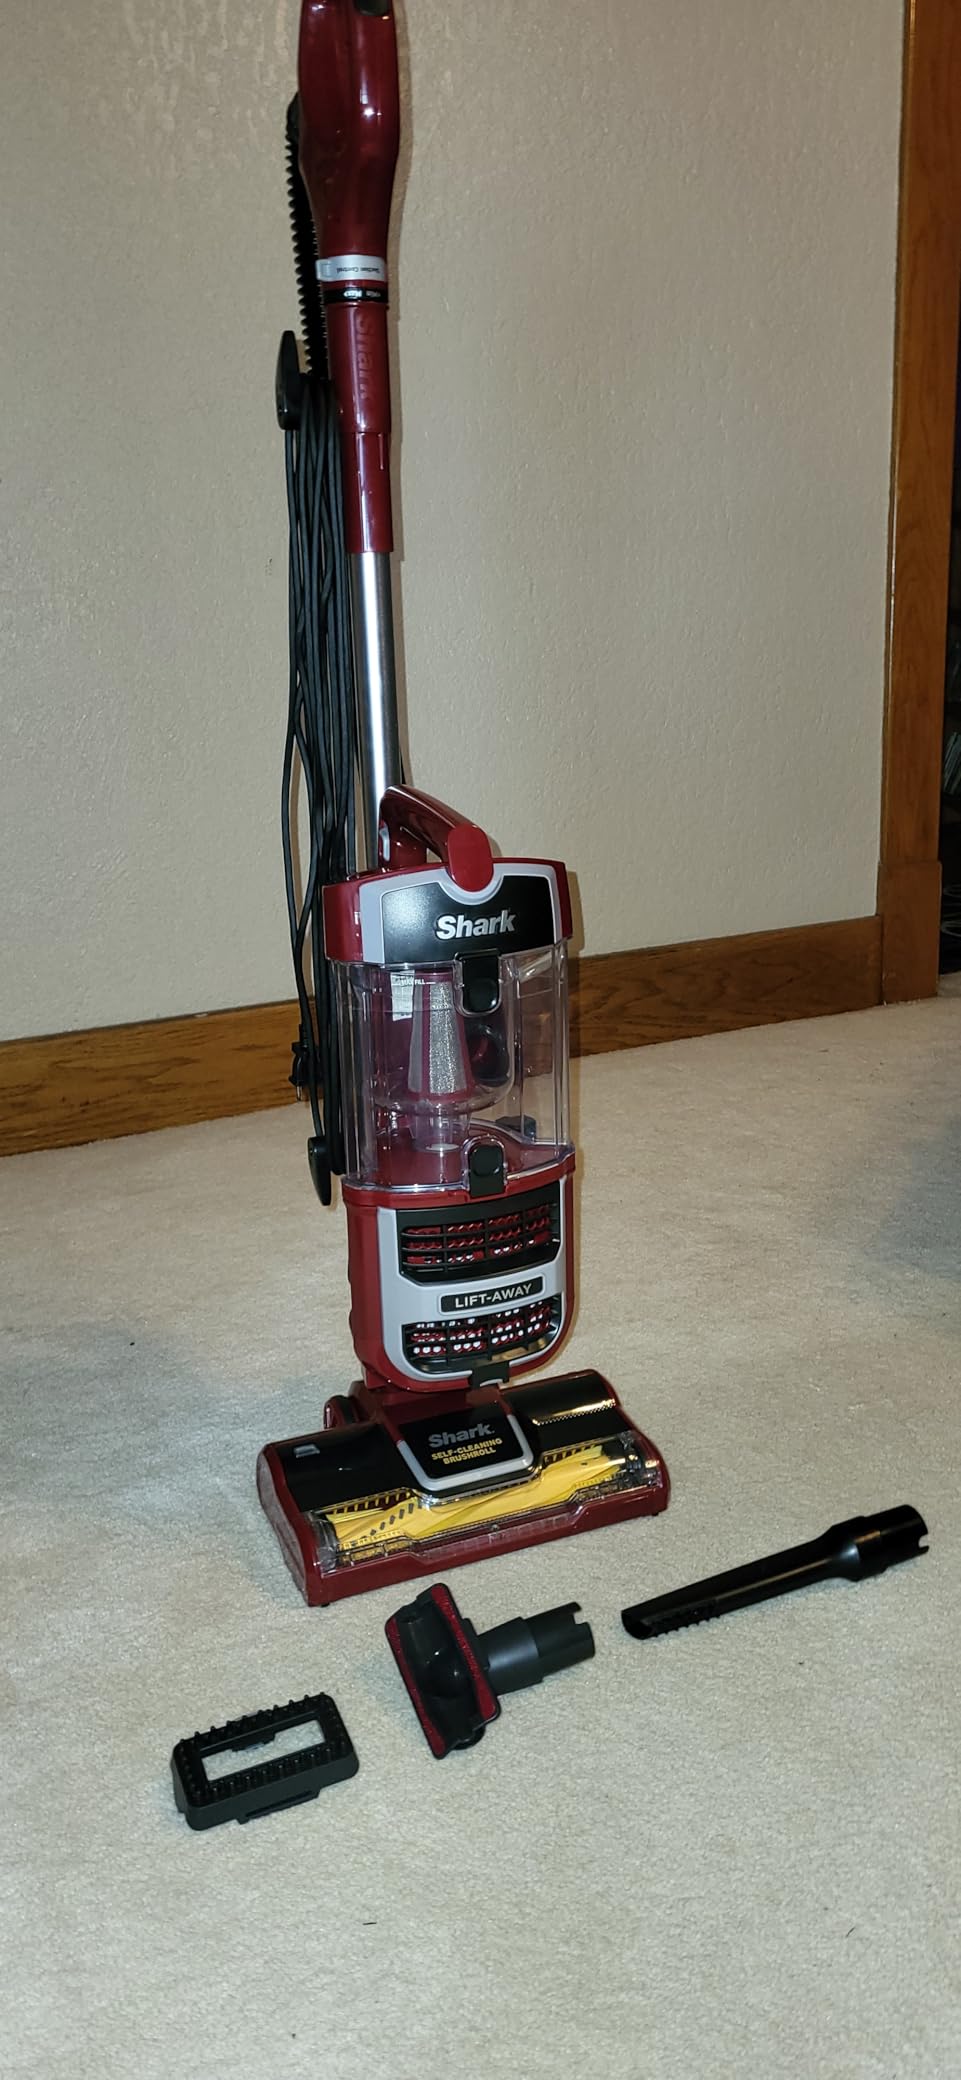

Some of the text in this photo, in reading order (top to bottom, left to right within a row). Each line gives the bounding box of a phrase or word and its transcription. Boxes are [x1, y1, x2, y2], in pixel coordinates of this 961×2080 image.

[436, 909, 517, 940] Shark
[454, 1283, 533, 1308] LIFT-AWAY
[431, 1437, 503, 1460] SELF-CLEANING
[442, 1446, 497, 1465] BRUSHROLL
